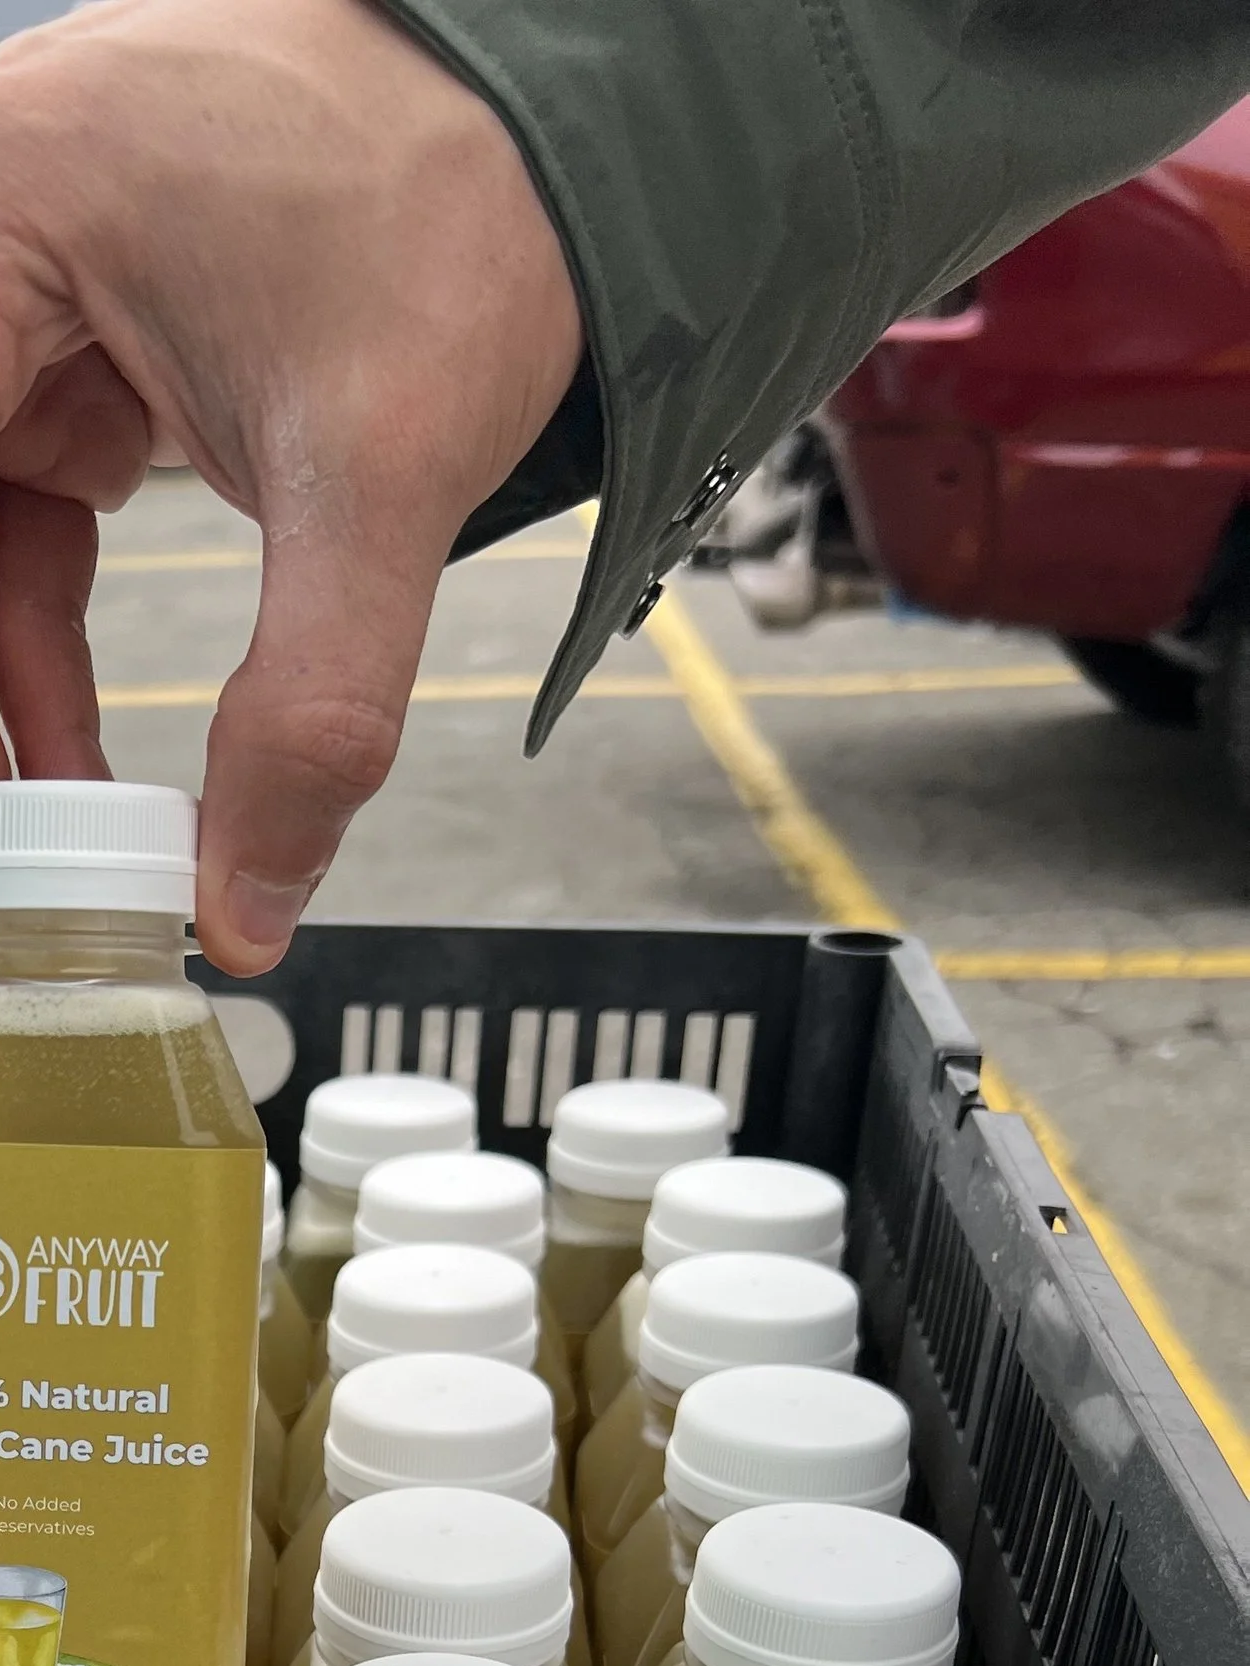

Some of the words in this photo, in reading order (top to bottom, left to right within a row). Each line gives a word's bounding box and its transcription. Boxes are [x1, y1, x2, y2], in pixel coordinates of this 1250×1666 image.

[27, 1236, 168, 1268] ANYWAY
[24, 1267, 164, 1328] FRUIT
[22, 1380, 169, 1414] Natural
[103, 1434, 209, 1466] Juice
[23, 1497, 81, 1512] Added
